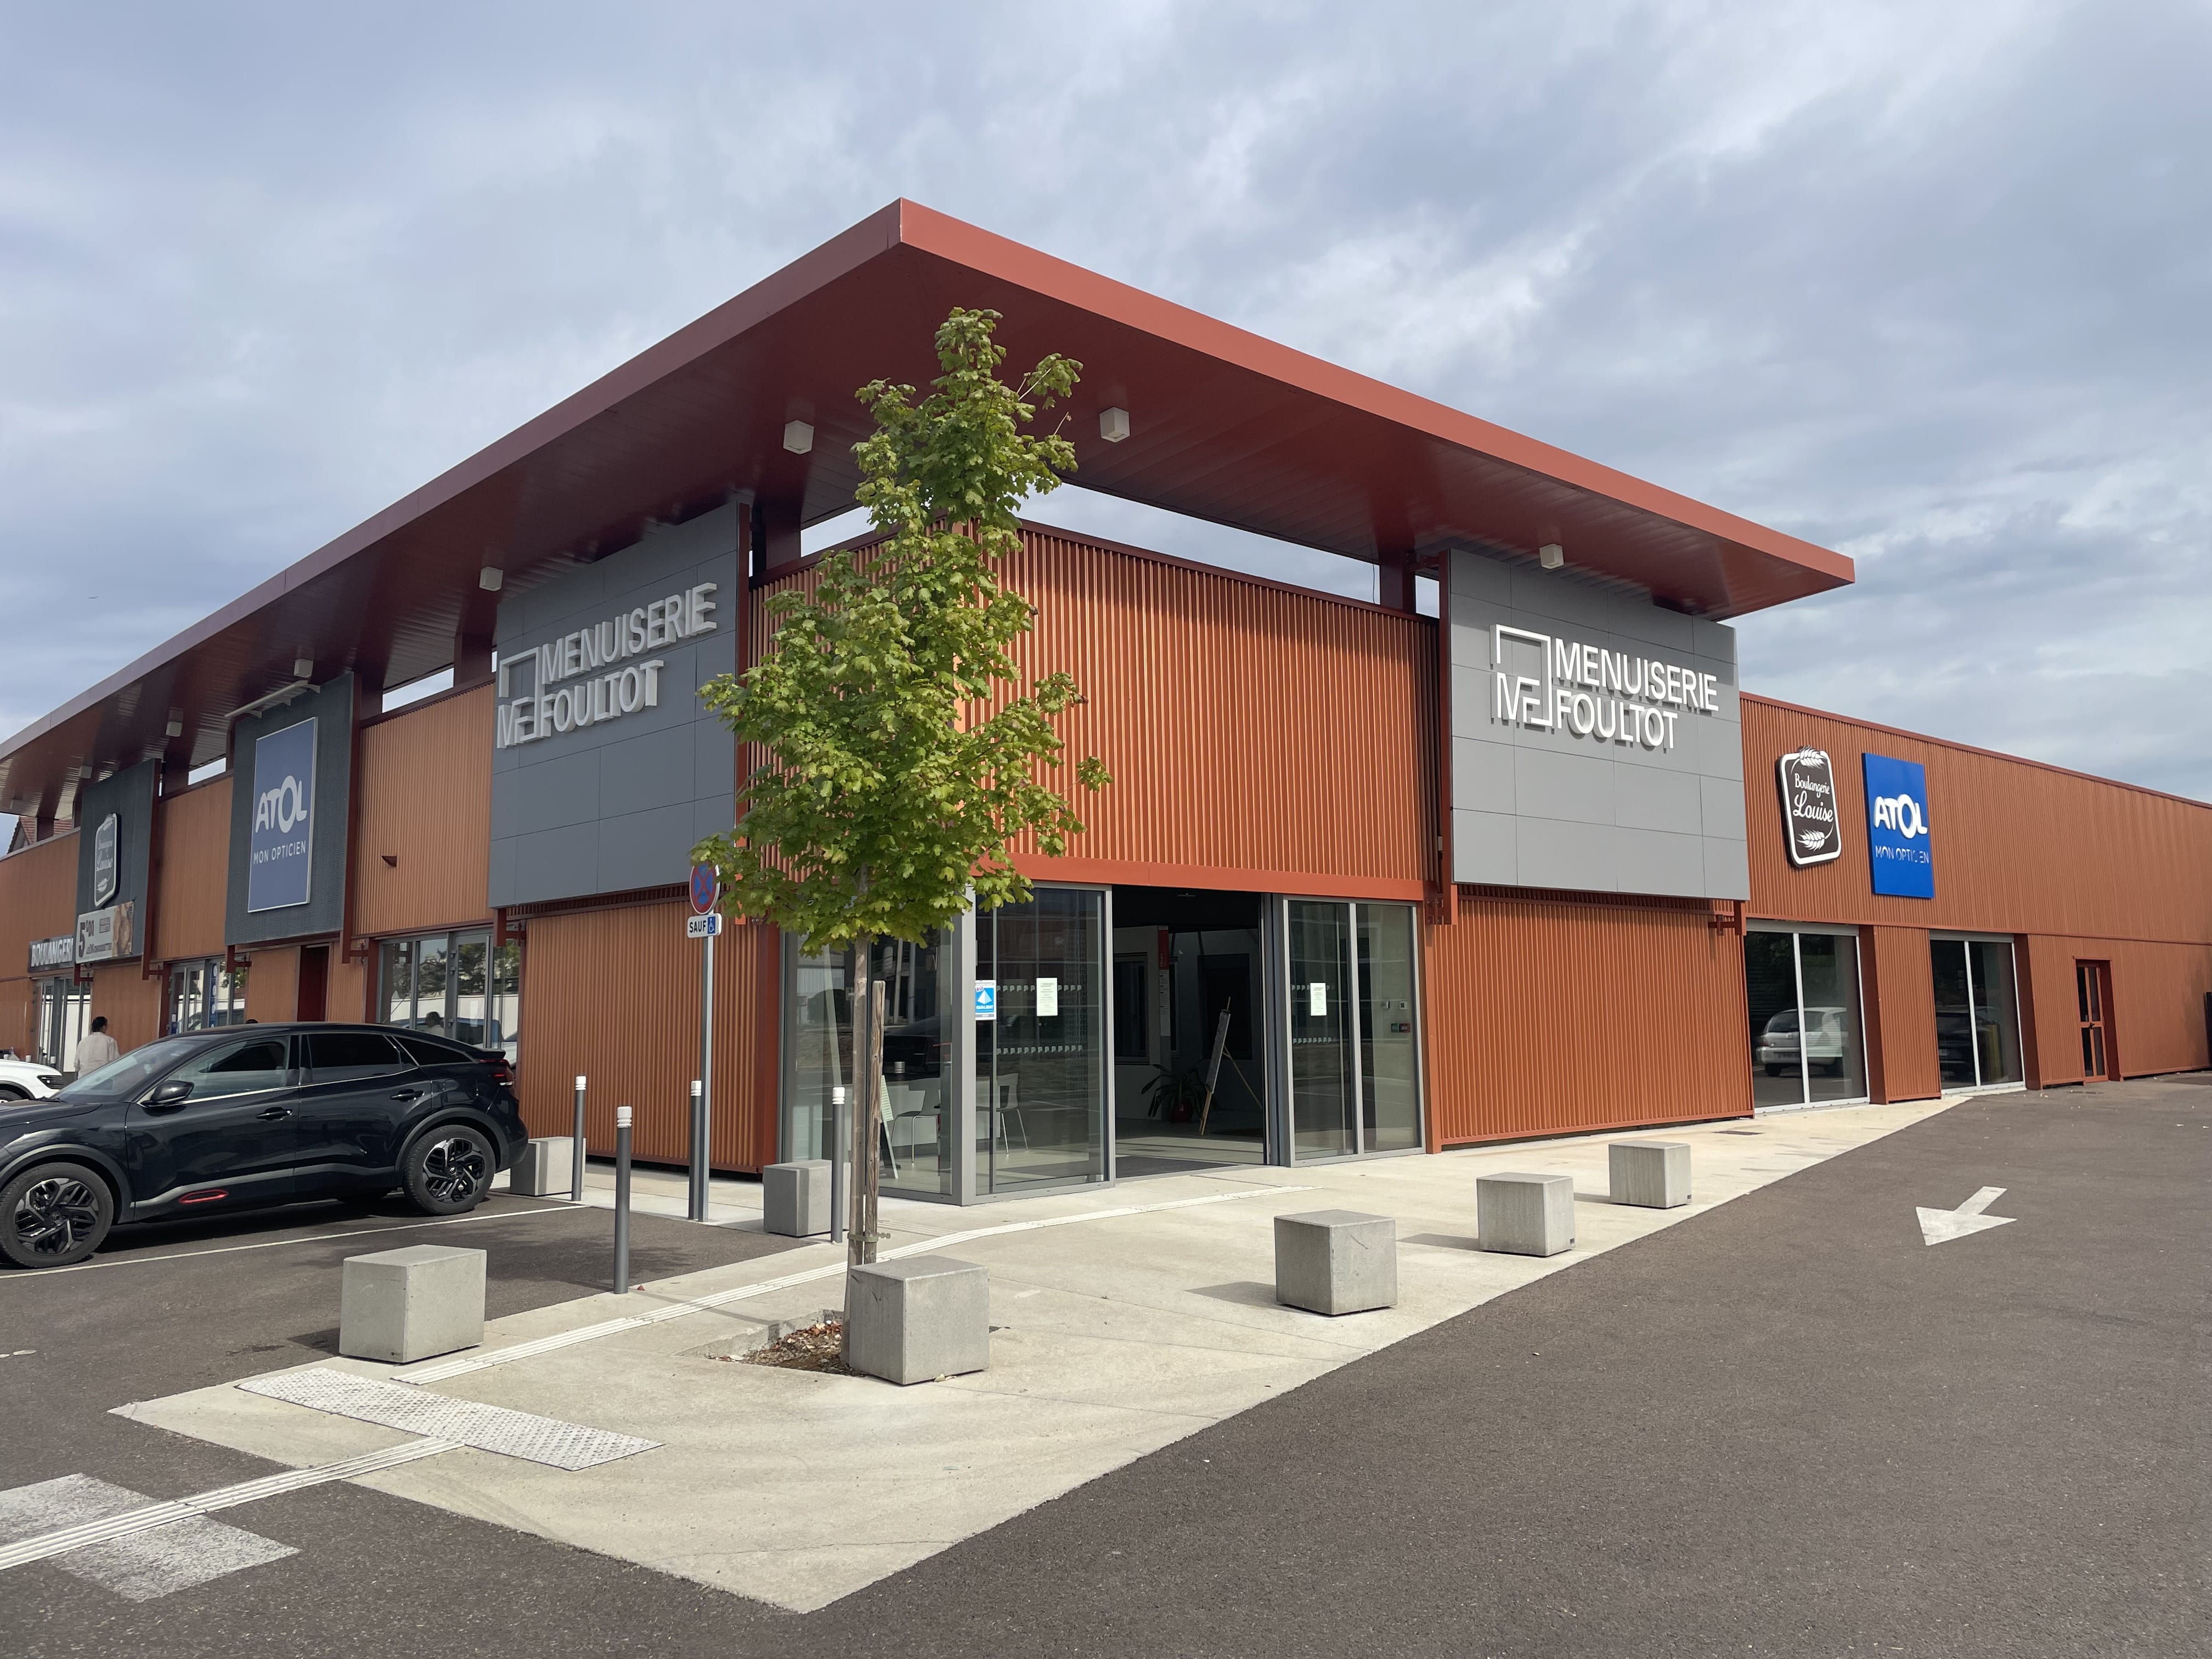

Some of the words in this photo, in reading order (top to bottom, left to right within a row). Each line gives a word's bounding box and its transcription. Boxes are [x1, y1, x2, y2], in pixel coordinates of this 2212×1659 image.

[542, 582, 717, 685] MENUISERIE
[1554, 638, 1719, 712] MENUISERIE
[540, 660, 664, 737] FOULTOT
[1556, 689, 1678, 749] FOULTOT
[255, 775, 307, 833] ATOL
[1795, 772, 1830, 798] Boulangerie
[1793, 790, 1833, 822] Louise
[1874, 794, 1928, 839] ATOL
[253, 849, 269, 865] MON
[272, 840, 306, 861] OPTICIEN
[1875, 845, 1894, 860] MON
[1895, 848, 1929, 864] OPTIEN
[689, 920, 707, 933] SAUF
[31, 938, 74, 967] BOULANGERI
